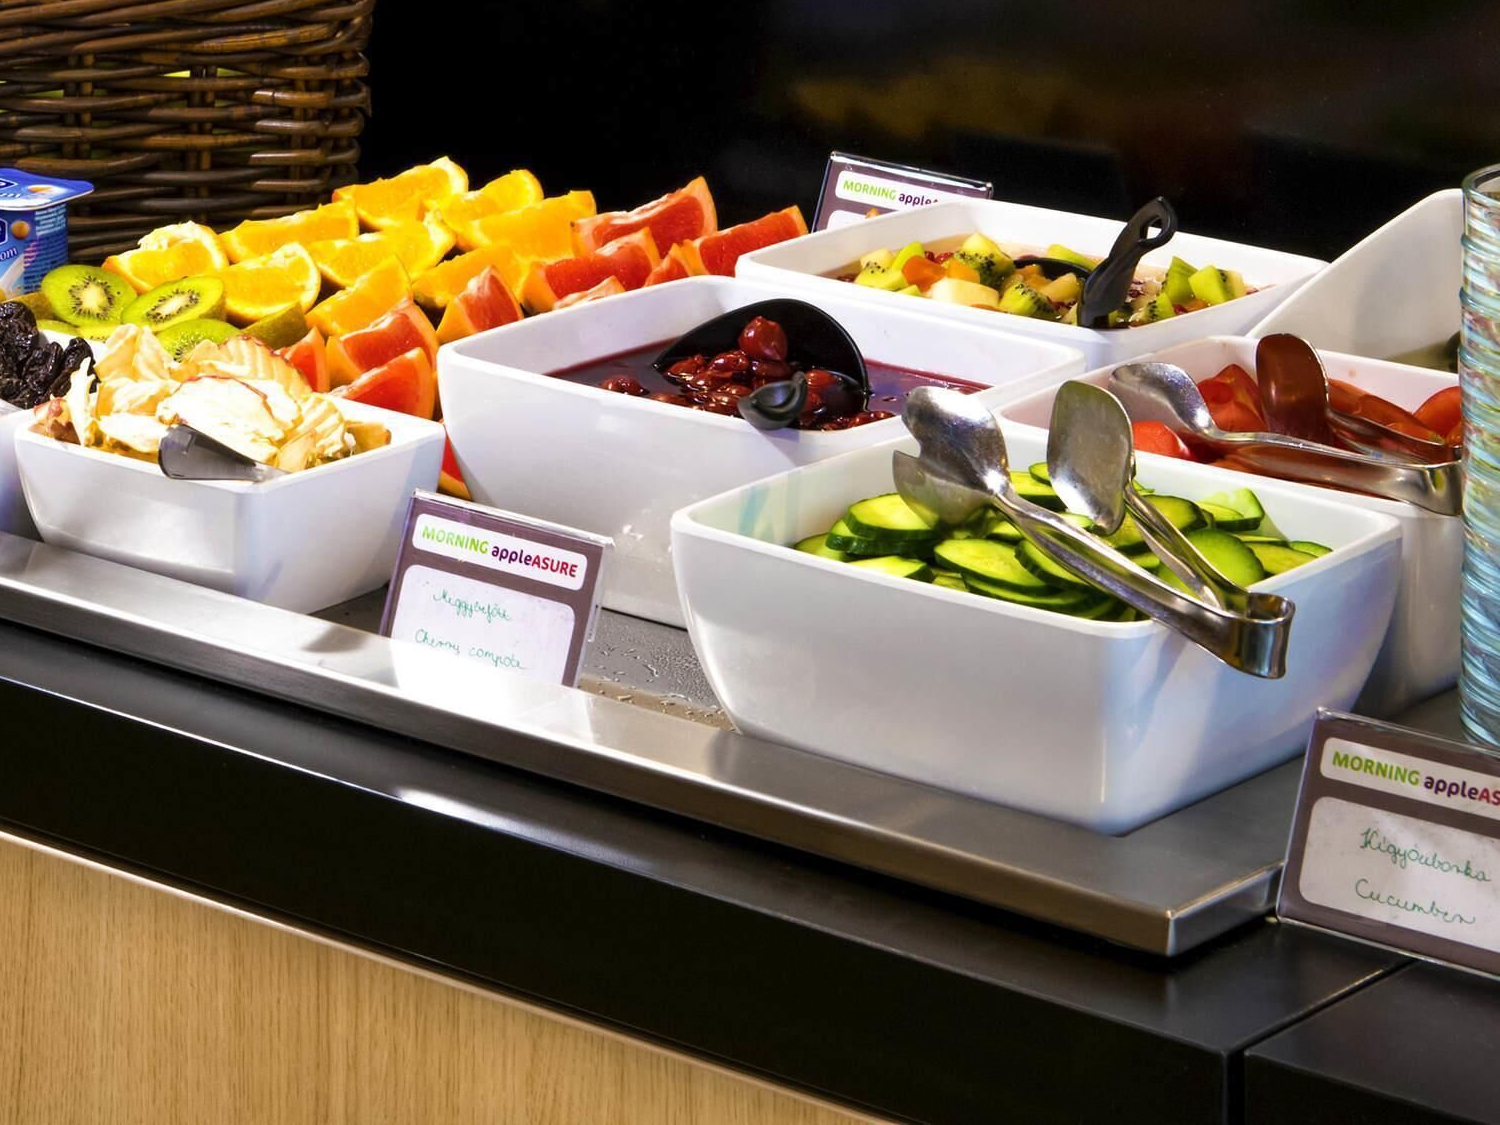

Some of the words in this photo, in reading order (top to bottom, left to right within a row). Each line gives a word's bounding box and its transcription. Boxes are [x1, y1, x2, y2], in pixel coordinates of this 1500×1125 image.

[843, 180, 896, 200] MORNING
[899, 193, 939, 207] apple
[422, 526, 488, 554] MORNING
[491, 544, 578, 577] appleASURE
[1332, 751, 1420, 785] MORNING
